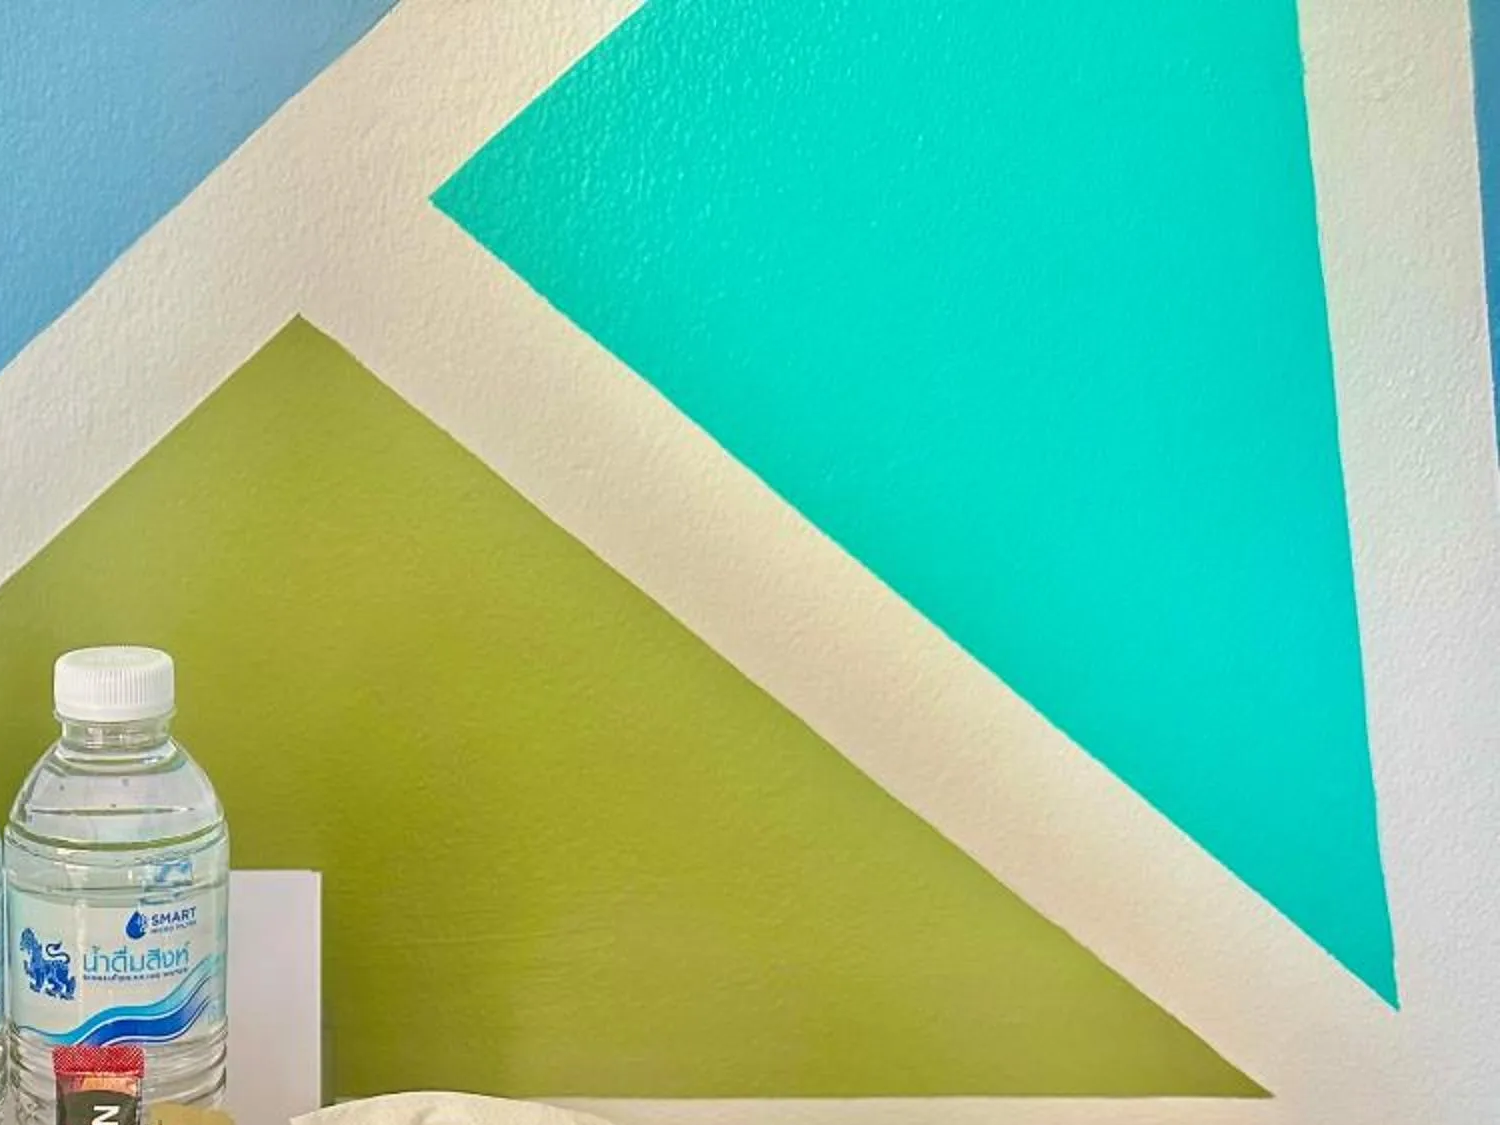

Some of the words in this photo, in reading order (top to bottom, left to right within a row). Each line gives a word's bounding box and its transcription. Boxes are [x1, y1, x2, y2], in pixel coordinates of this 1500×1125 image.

[151, 906, 197, 928] SMART
[83, 941, 191, 973] น้ำดื่มสิงห์
